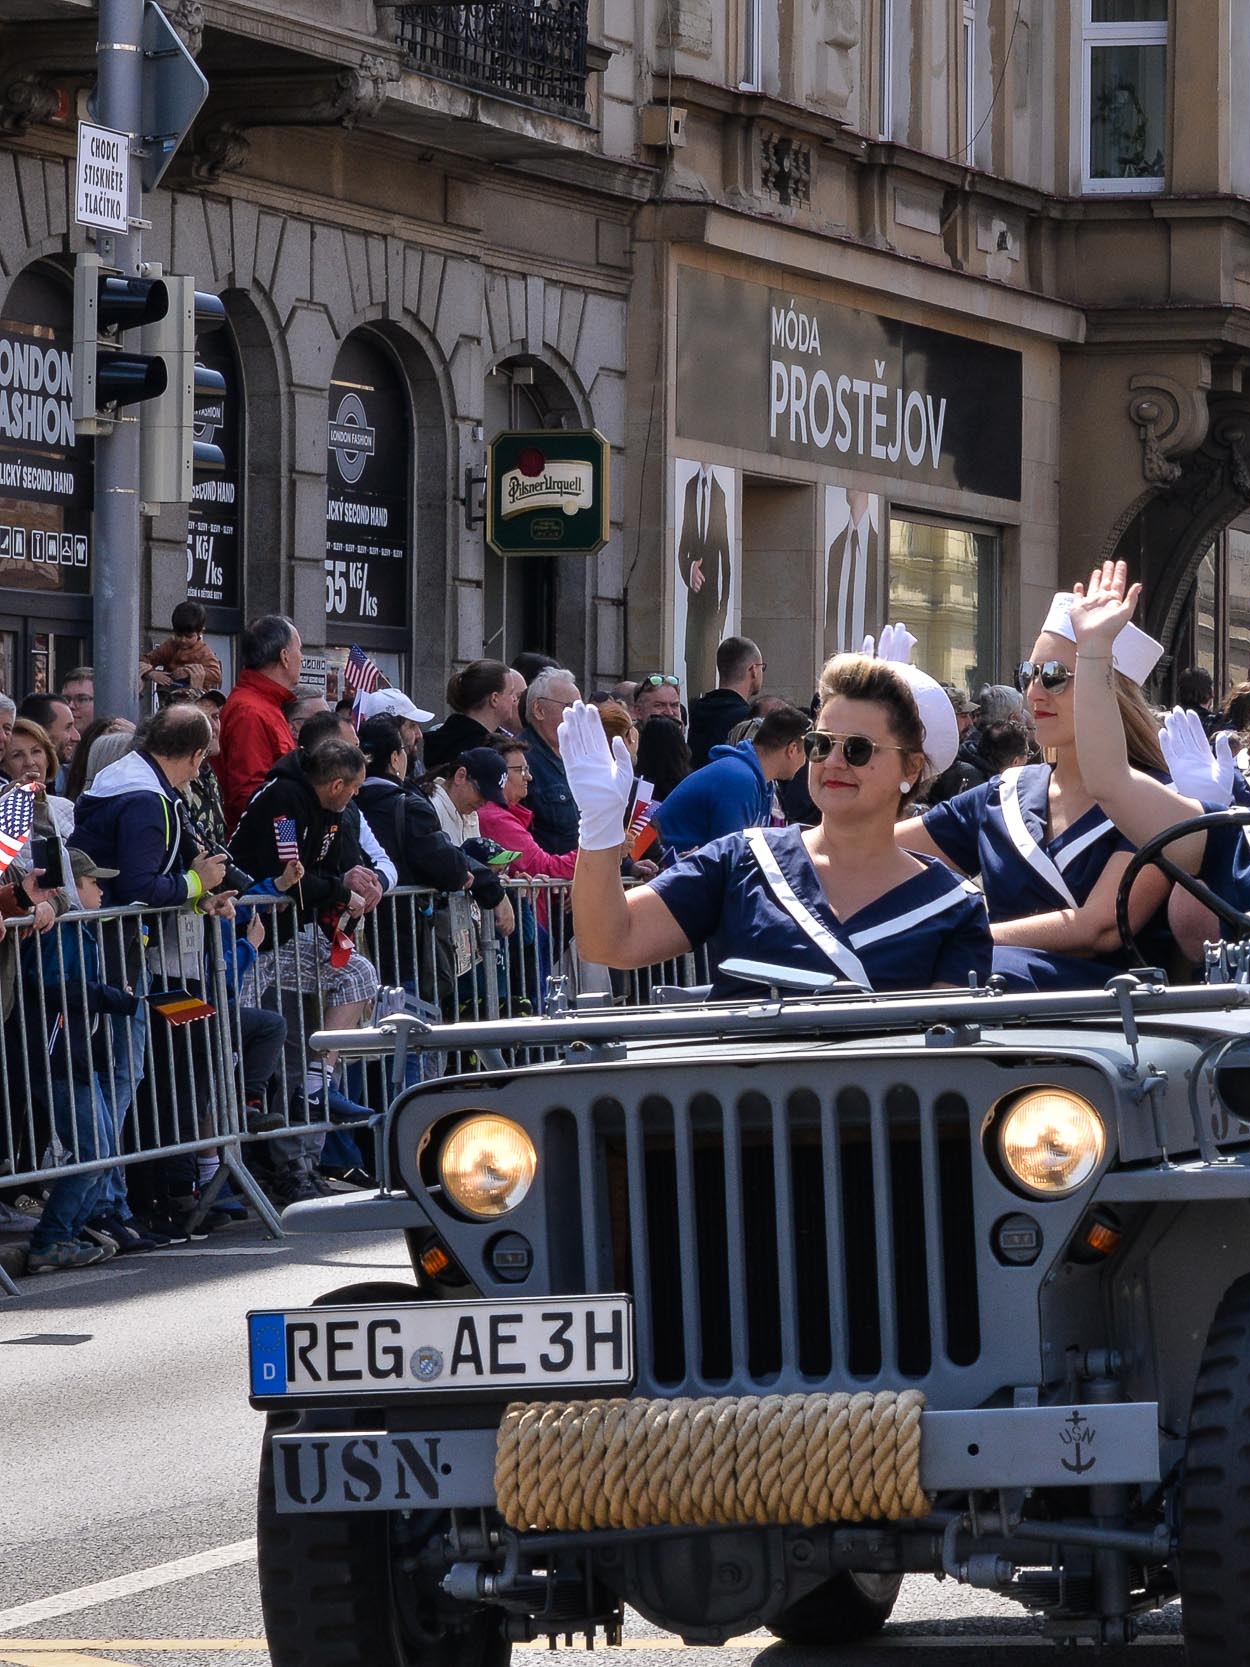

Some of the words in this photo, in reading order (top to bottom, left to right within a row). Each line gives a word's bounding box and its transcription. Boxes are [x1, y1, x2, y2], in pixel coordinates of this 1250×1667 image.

[90, 136, 119, 163] CHODCI
[83, 164, 123, 193] STISKNĚTE
[84, 191, 121, 221] TLAČÍTKO
[772, 299, 821, 357] MÓDA
[0, 339, 74, 397] ONDON
[0, 390, 75, 447] ASHION
[770, 359, 947, 470] PROSTĚJOV
[330, 429, 351, 443] LONDON
[351, 433, 372, 447] FASHION
[22, 465, 52, 492] SECOND
[53, 471, 74, 495] HAND
[217, 481, 235, 504] HAND
[508, 475, 545, 504] Pilsner
[344, 501, 370, 525] SECOND
[370, 506, 388, 528] HAND
[263, 1362, 276, 1381] D
[285, 1318, 404, 1383] REG
[449, 1313, 527, 1376] AE
[538, 1309, 624, 1373] 3H
[1058, 1426, 1096, 1445] USN
[278, 1437, 442, 1505] USN
